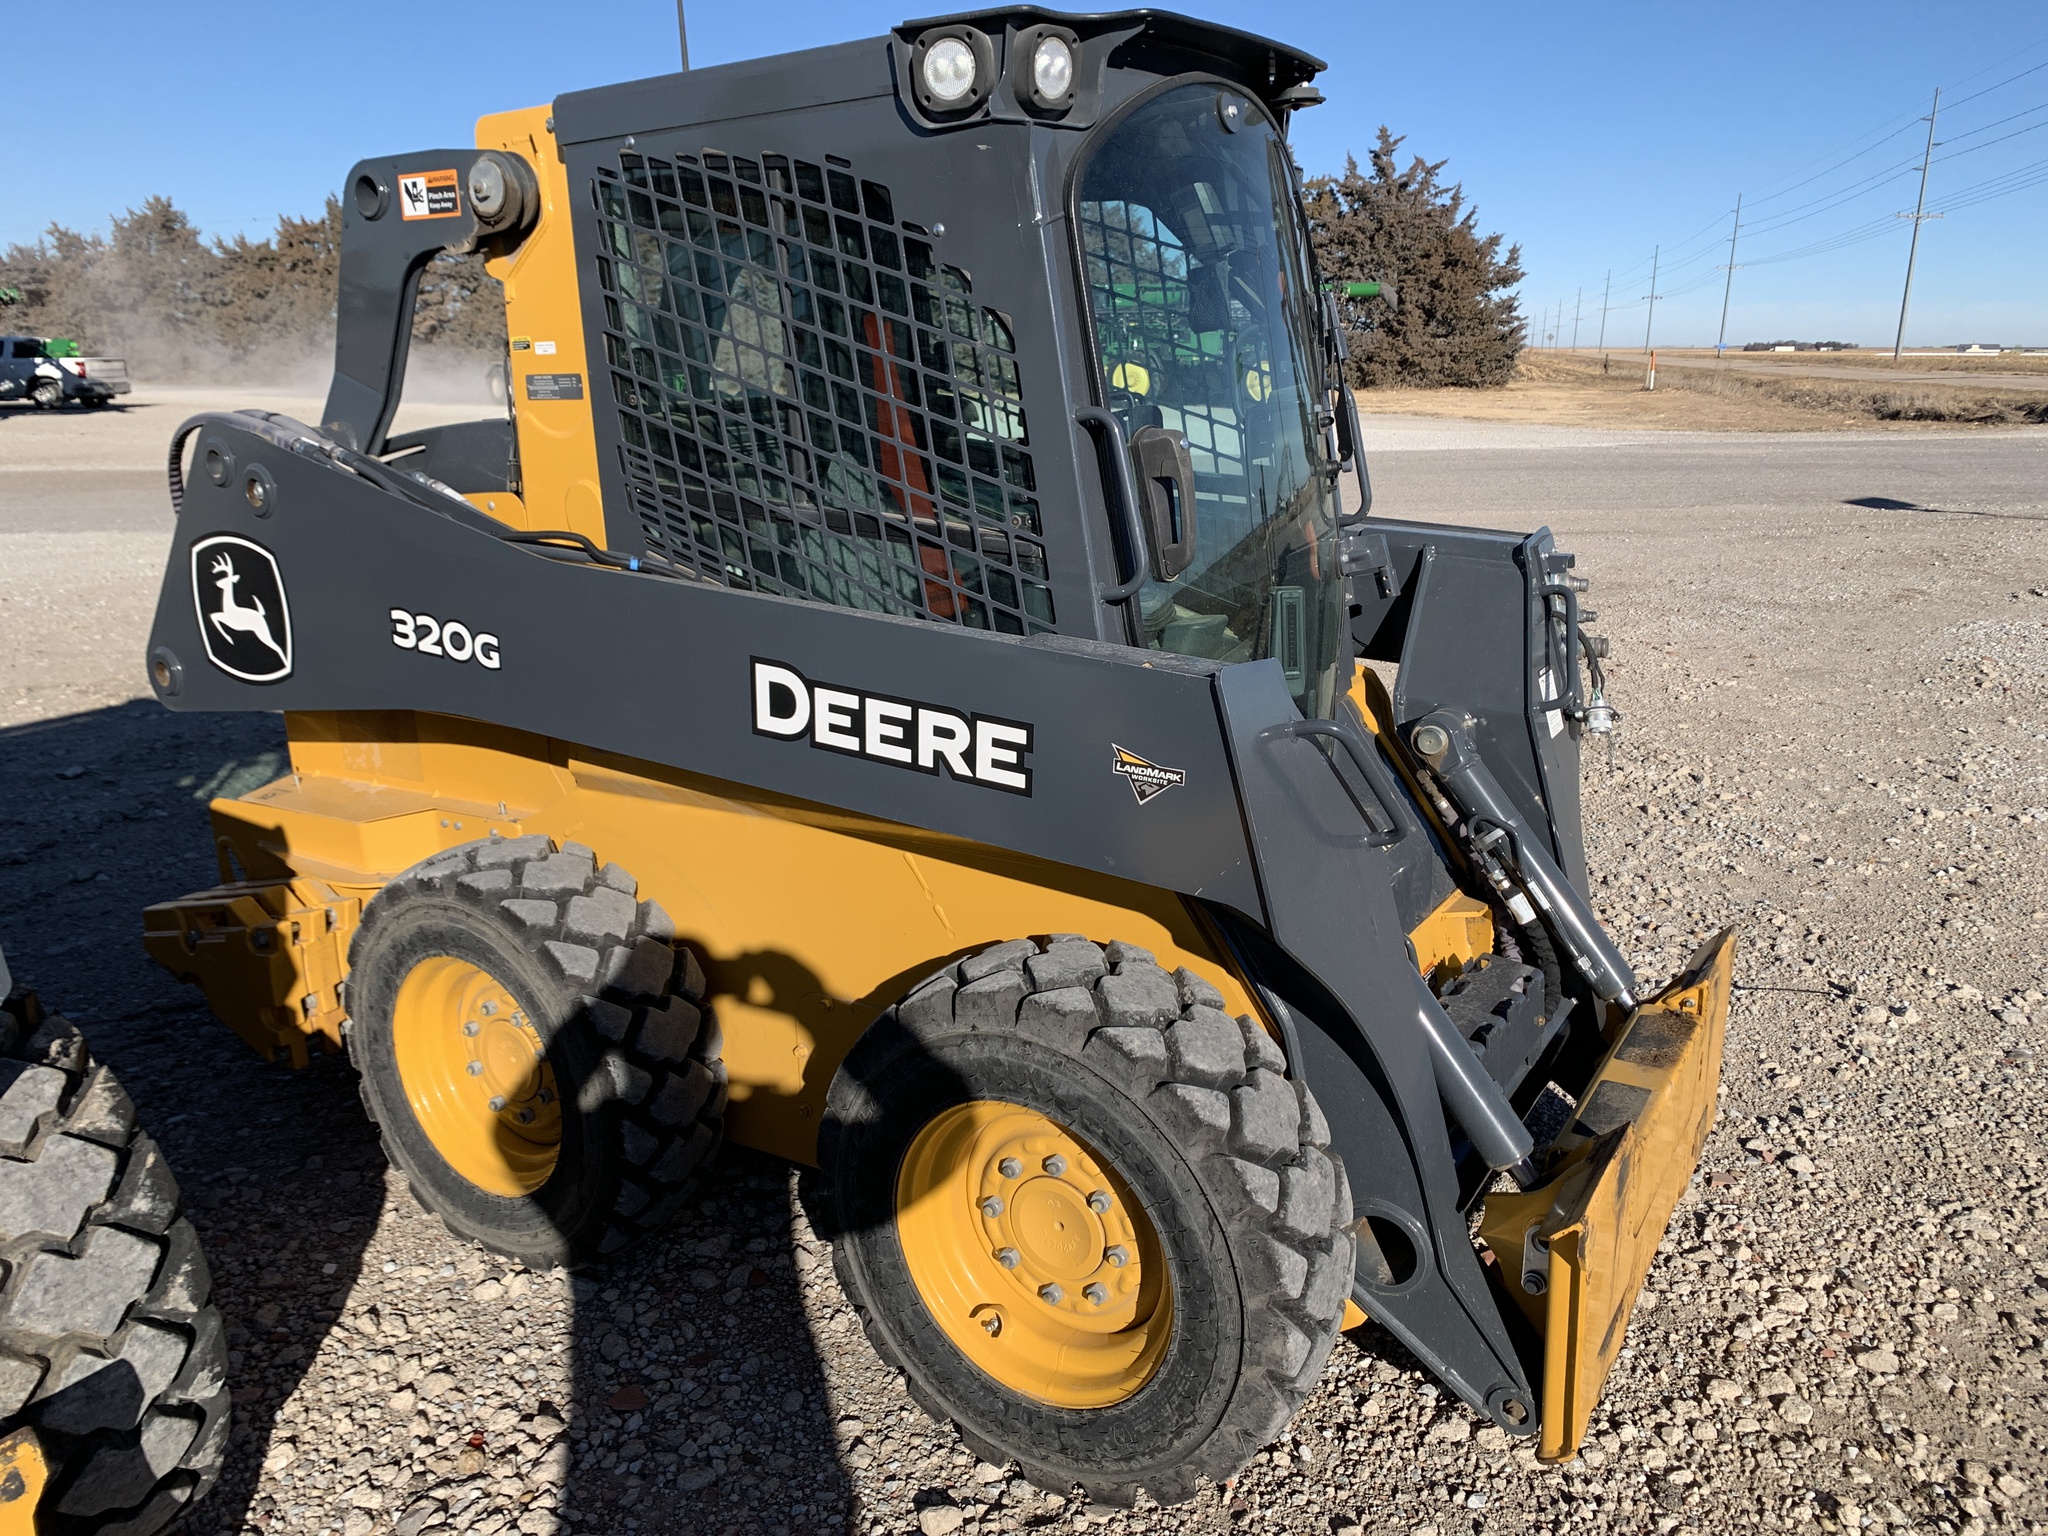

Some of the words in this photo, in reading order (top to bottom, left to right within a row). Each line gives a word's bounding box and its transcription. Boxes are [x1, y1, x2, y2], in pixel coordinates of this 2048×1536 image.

[428, 192, 443, 200] Pinch
[390, 608, 501, 669] 320G
[754, 662, 1029, 790] DEERE
[1116, 762, 1182, 782] LANDMARK
[1131, 773, 1168, 786] WORKSITE
